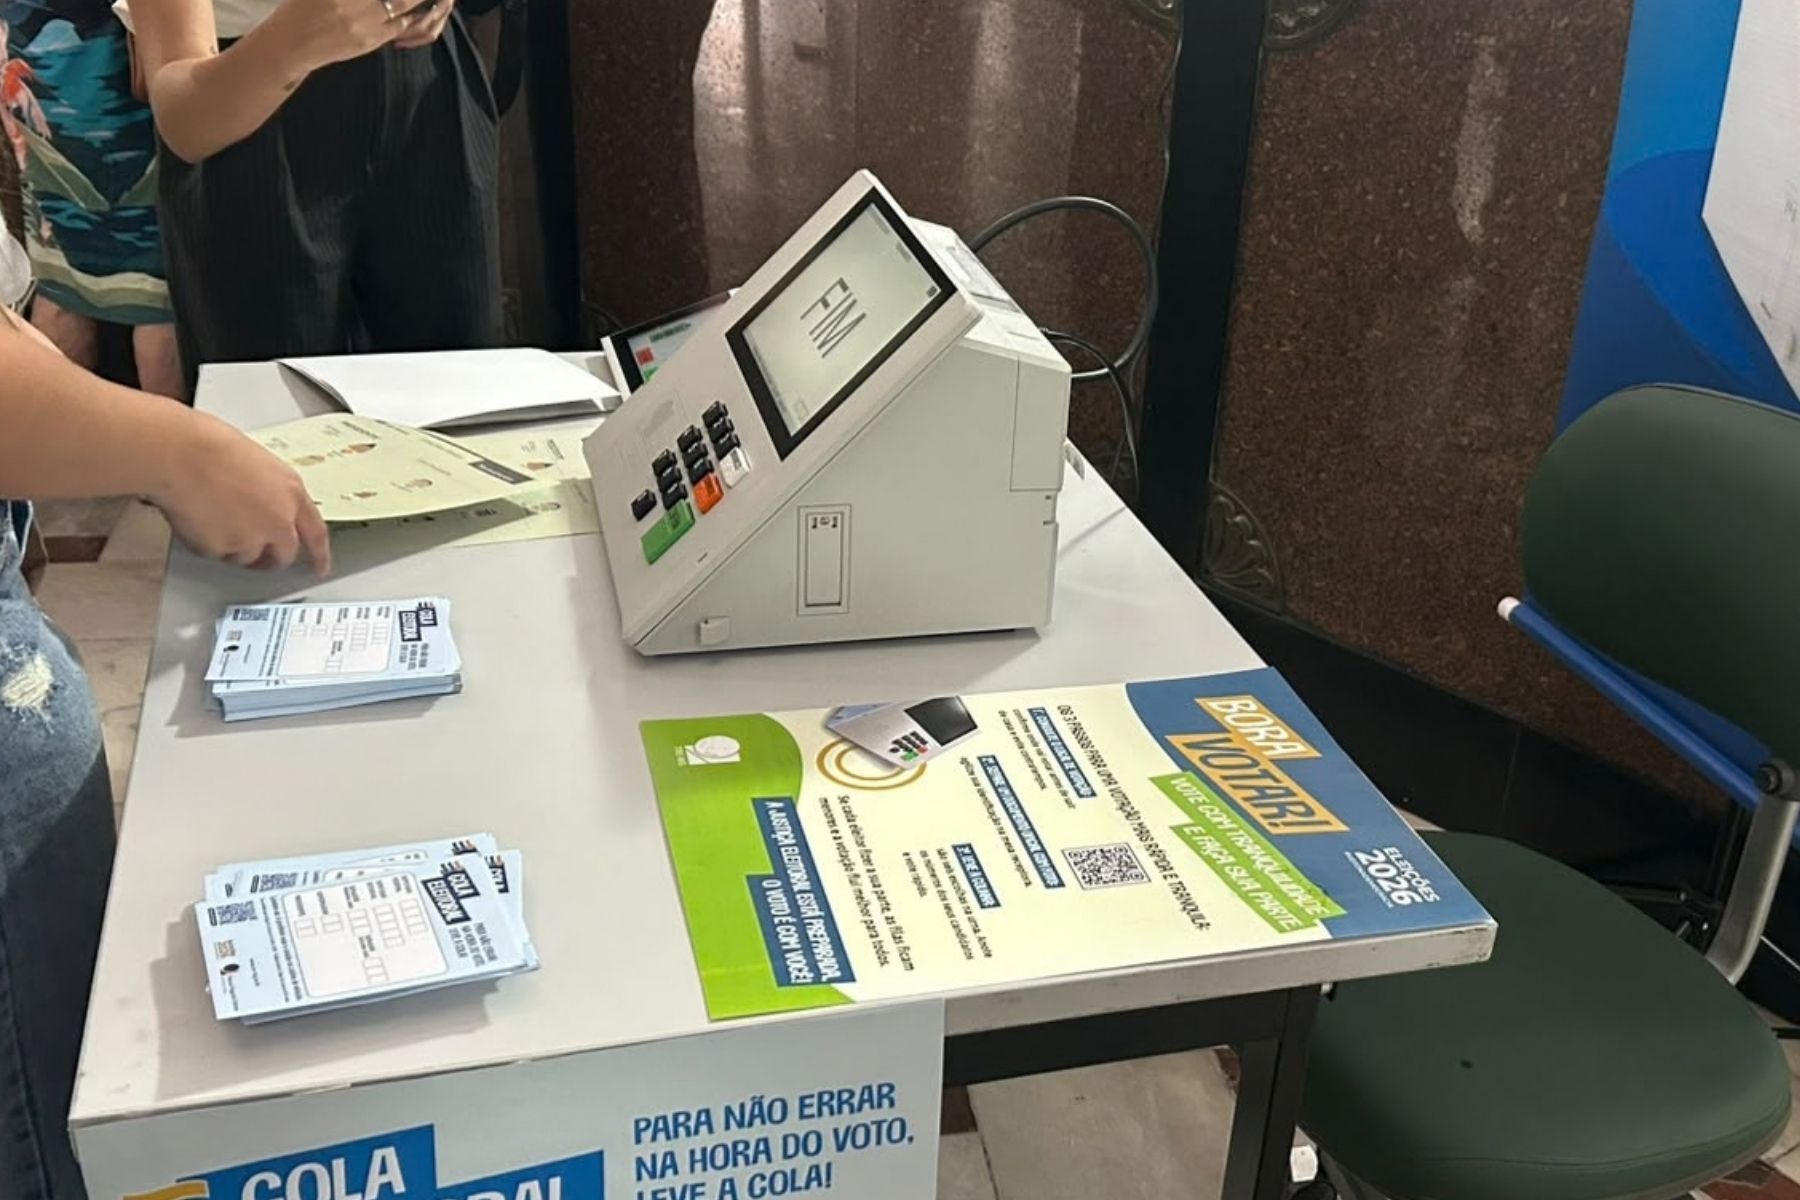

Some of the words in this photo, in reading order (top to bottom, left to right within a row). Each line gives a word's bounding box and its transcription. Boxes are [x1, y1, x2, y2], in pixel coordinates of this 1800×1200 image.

[800, 277, 866, 358] FIM
[1209, 698, 1306, 758] BORA
[1182, 734, 1330, 831] VOTAR!
[769, 809, 796, 845] JUSTIÇA
[820, 797, 837, 828] menores
[842, 805, 857, 823] cada
[1067, 722, 1095, 749] PASSOS
[1085, 750, 1107, 769] PARA
[1097, 769, 1118, 787] UMA
[1108, 786, 1141, 821] VOTAÇÃO
[1130, 822, 1154, 842] MAIS
[1144, 843, 1174, 873] RÁPIDA
[1168, 881, 1211, 930] TRANQUILA:
[849, 824, 866, 848] eleitor
[1170, 777, 1204, 804] VOTE
[1198, 805, 1235, 829] COM
[1229, 831, 1328, 916] TRANQUILIDADE
[781, 846, 810, 892] ELEITORAL
[835, 842, 855, 872] votação
[859, 849, 874, 867] fizer
[1183, 826, 1205, 834] E
[1194, 836, 1235, 864] FAÇA
[1225, 866, 1261, 891] SUA
[446, 872, 475, 899] COLA
[762, 879, 782, 888] O
[848, 873, 861, 886] flui
[868, 874, 882, 889] sua
[1354, 848, 1423, 906] 2026
[1383, 846, 1440, 903] ELEIÇÕES
[766, 889, 790, 915] VOTO
[796, 893, 824, 917] ESTÁ
[853, 888, 872, 917] melhor
[872, 890, 891, 914] parte,
[774, 916, 797, 924] É
[861, 919, 879, 939] para
[776, 925, 801, 949] COM
[889, 926, 904, 944] filas
[785, 950, 814, 983] VOCÊ!
[872, 940, 889, 967] todos.
[898, 946, 915, 971] ficam
[634, 1107, 714, 1145] PARA
[724, 1095, 788, 1131] NÃO
[798, 1082, 896, 1120] ERRAR
[635, 1150, 679, 1182] NA
[689, 1137, 772, 1174] HORA
[782, 1130, 822, 1160] DO
[240, 1146, 408, 1200] COLA
[717, 1177, 738, 1200] A
[747, 1162, 832, 1199] COLA!
